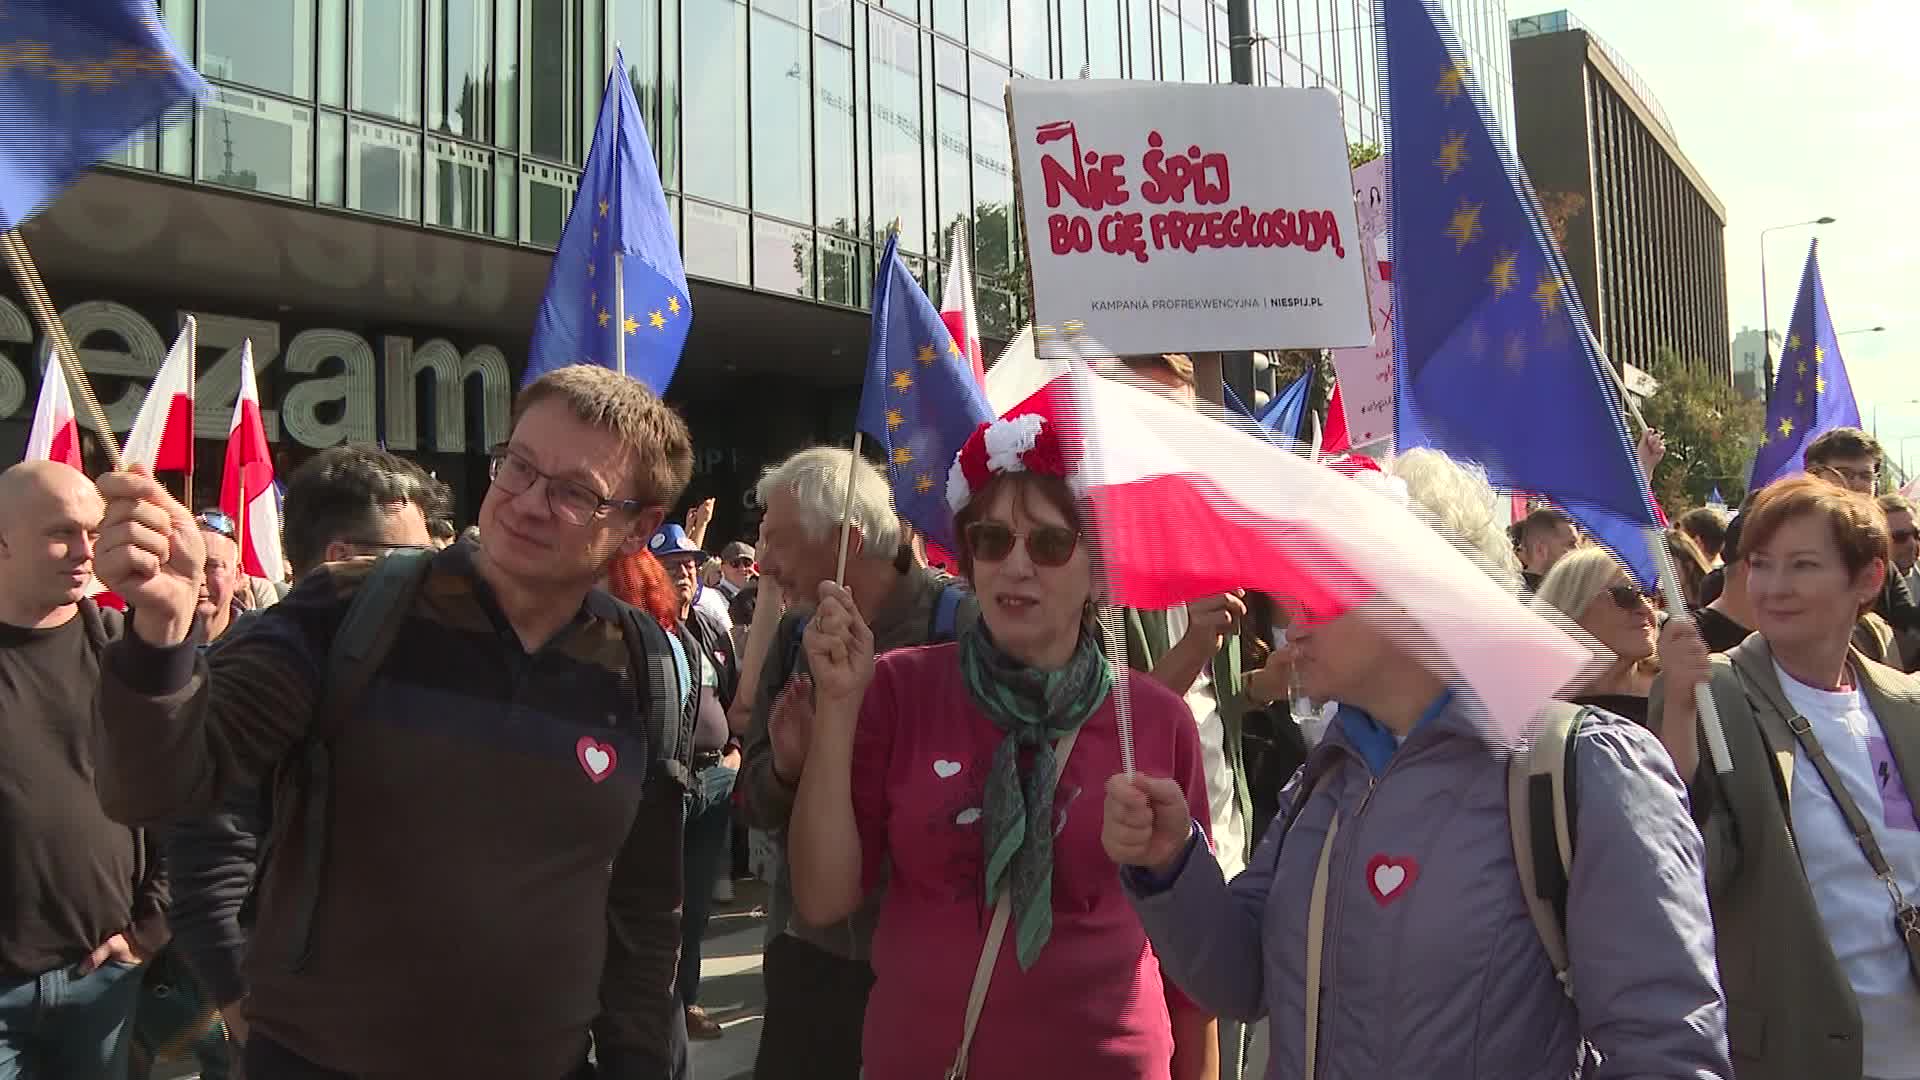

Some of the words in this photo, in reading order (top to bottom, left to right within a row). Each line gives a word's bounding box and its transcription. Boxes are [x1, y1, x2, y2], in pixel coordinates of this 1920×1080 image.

[1048, 212, 1092, 255] BO
[1091, 299, 1150, 312] KAMPANIA
[1152, 298, 1260, 310] PROFREKWENCYJNA
[1270, 297, 1323, 308] NIESPIJ.PL
